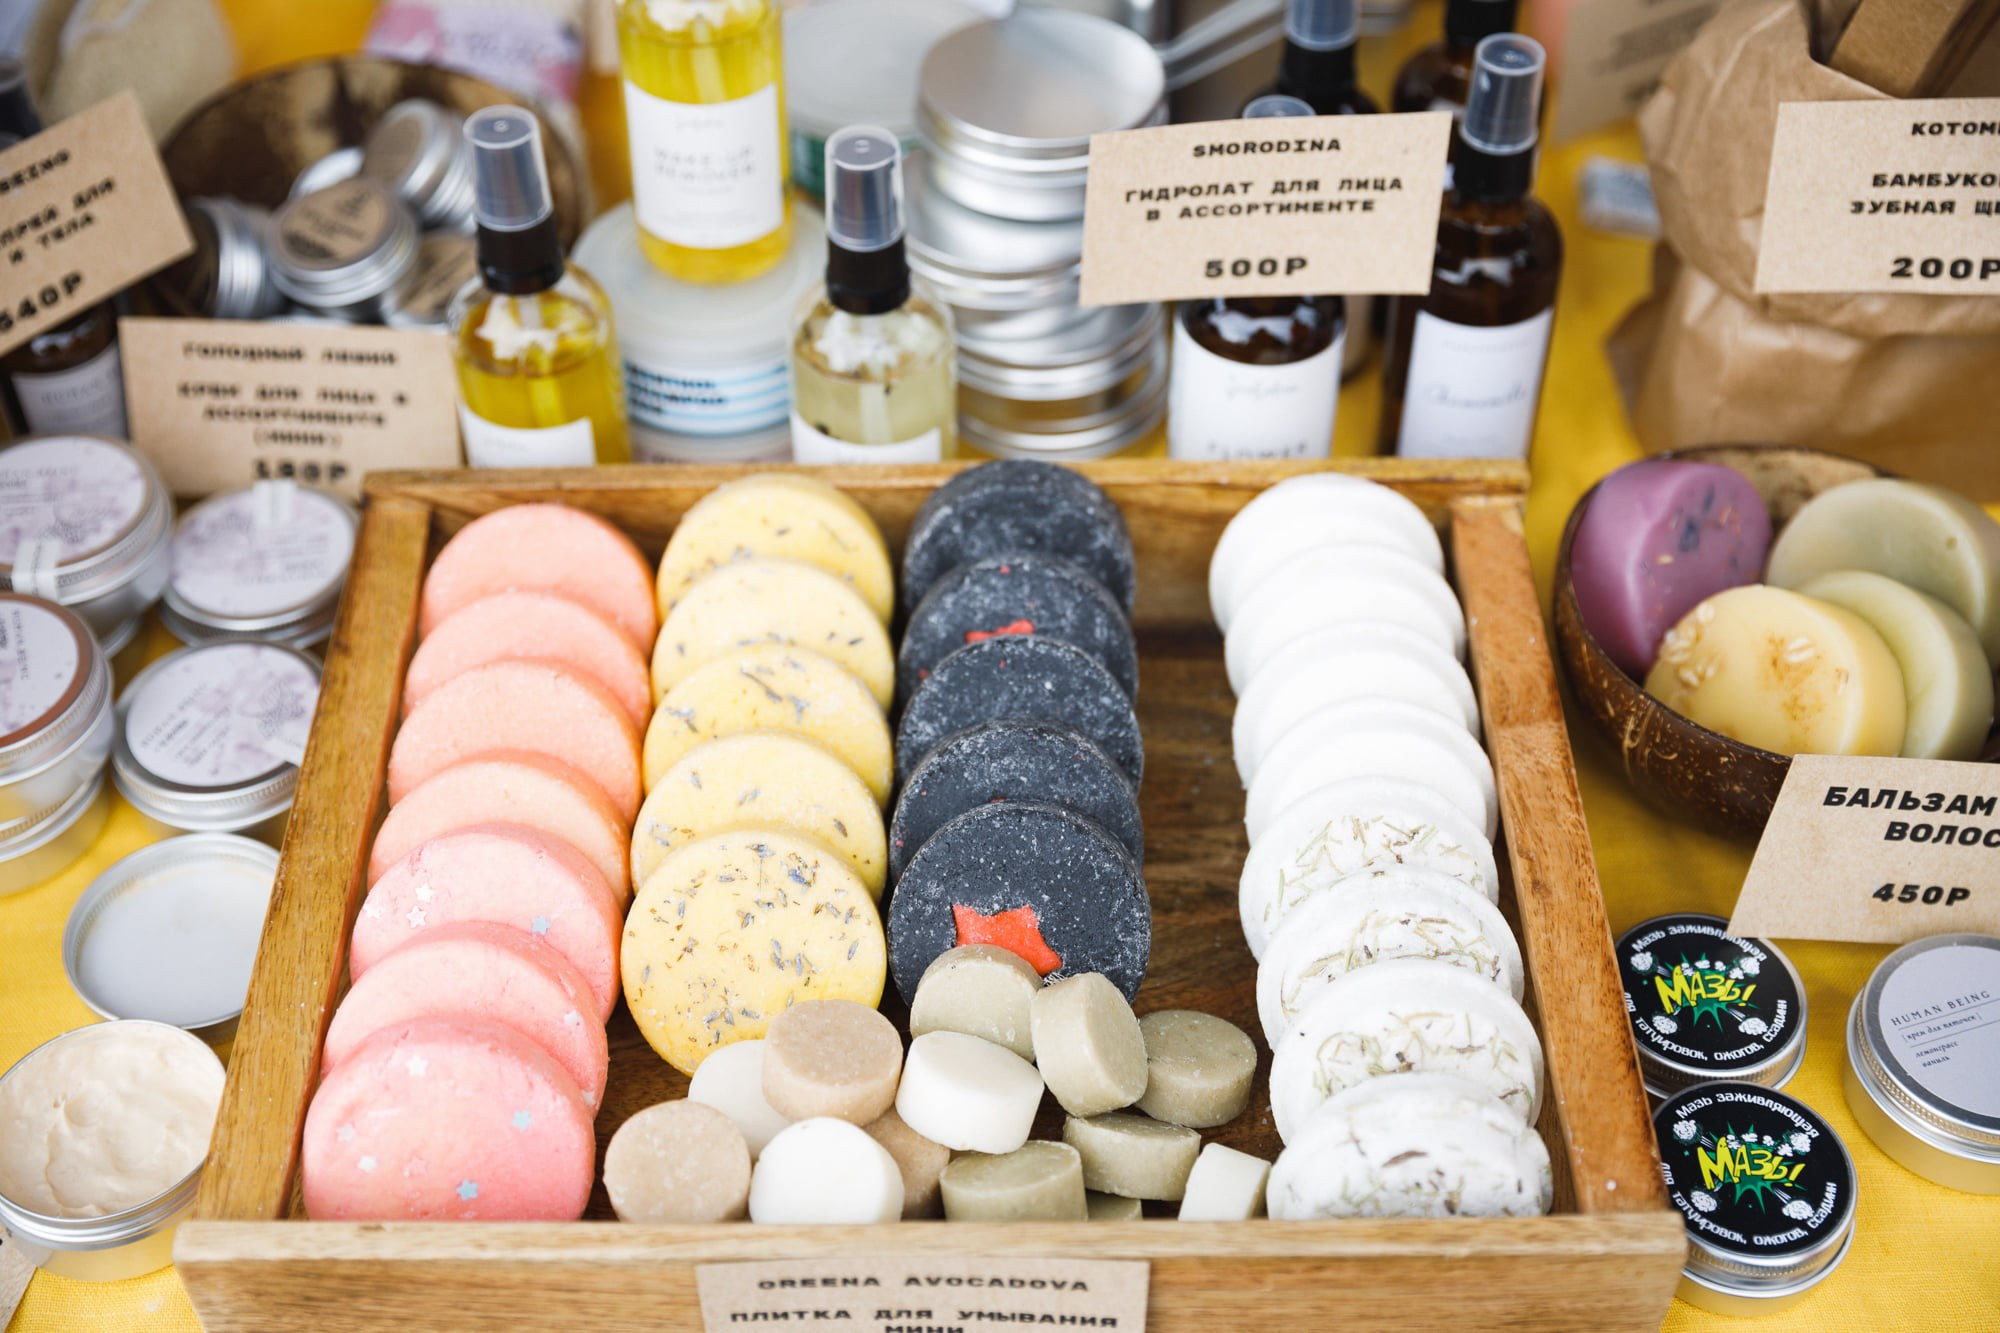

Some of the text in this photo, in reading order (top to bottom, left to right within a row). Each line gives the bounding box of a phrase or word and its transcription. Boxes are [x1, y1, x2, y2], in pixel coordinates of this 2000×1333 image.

[1912, 122, 2000, 135] КОТОМ
[1194, 139, 1340, 157] SMORODINA
[1126, 178, 1402, 202] ГИДРОЛАТ ДЛЯ ЛИЦА
[1872, 173, 2000, 187] БАМБУКО
[73, 178, 115, 210] ДЛЯ
[1147, 200, 1374, 221] В АССОРТИМЕНТЕ
[1851, 201, 1955, 214] ЗУБНАЯ
[39, 212, 94, 247] ТЕЛА
[1205, 257, 1307, 278] 500Р
[1891, 257, 2000, 280] 200Р
[1823, 787, 1998, 816] БАЛЬЗАМ
[1872, 883, 1970, 906] 450Р
[1631, 929, 1667, 952] Мазь
[1654, 965, 1757, 1014] МАЗЬ!
[1891, 991, 1990, 1026] HUMAN BEING
[1635, 1016, 1708, 1062] татуировок,
[1713, 1043, 1765, 1062] ожогов,
[1762, 999, 1788, 1043] ссадин
[1675, 1092, 1820, 1139] Мазь заживляющая
[1696, 1136, 1806, 1190] МАЗЬ!
[1672, 1191, 1748, 1245] татуировок,
[1753, 1227, 1809, 1246] ожогов,
[1807, 1181, 1838, 1229] ссадин
[905, 1277, 1087, 1291] AVOCADOVA
[731, 1310, 1118, 1328] ПЛИТКА ДЛЯ УМЫВАНИЯ
